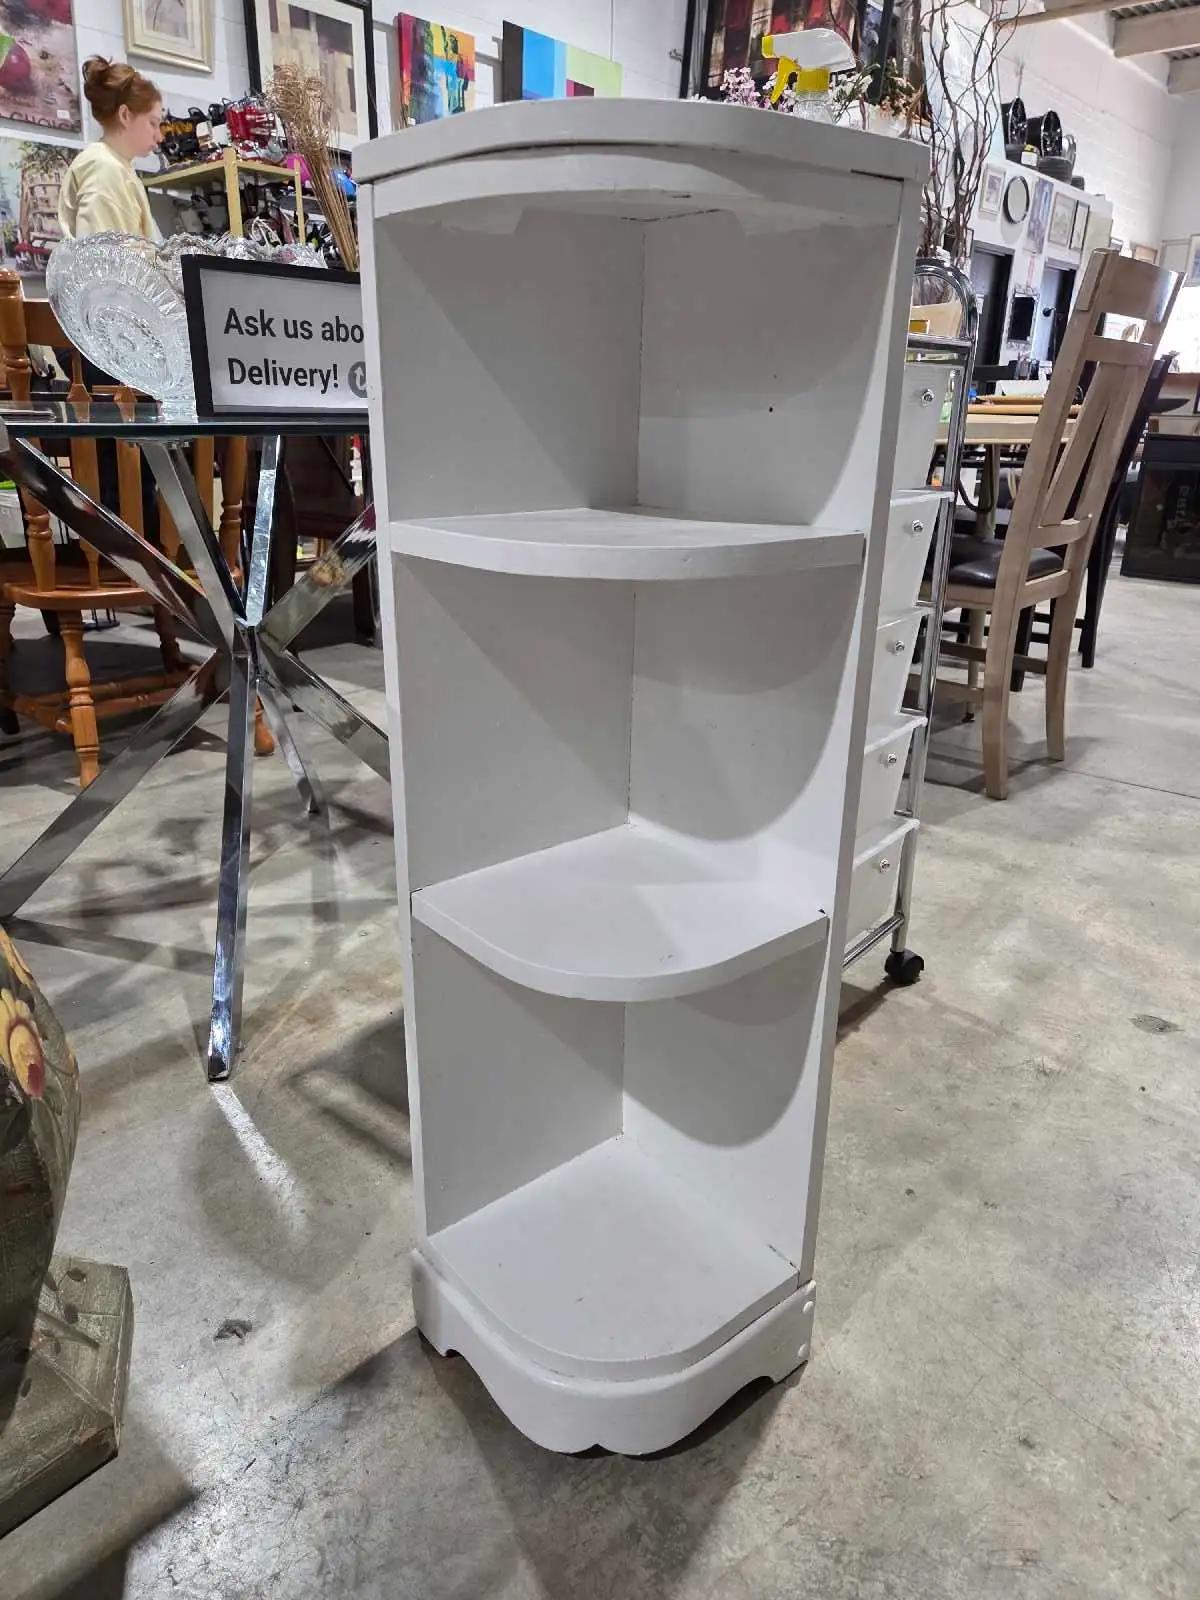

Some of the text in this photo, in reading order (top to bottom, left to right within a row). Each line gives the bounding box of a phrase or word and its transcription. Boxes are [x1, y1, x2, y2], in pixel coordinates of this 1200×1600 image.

[224, 307, 365, 344] Ask us abo
[227, 357, 339, 395] Delivery!
